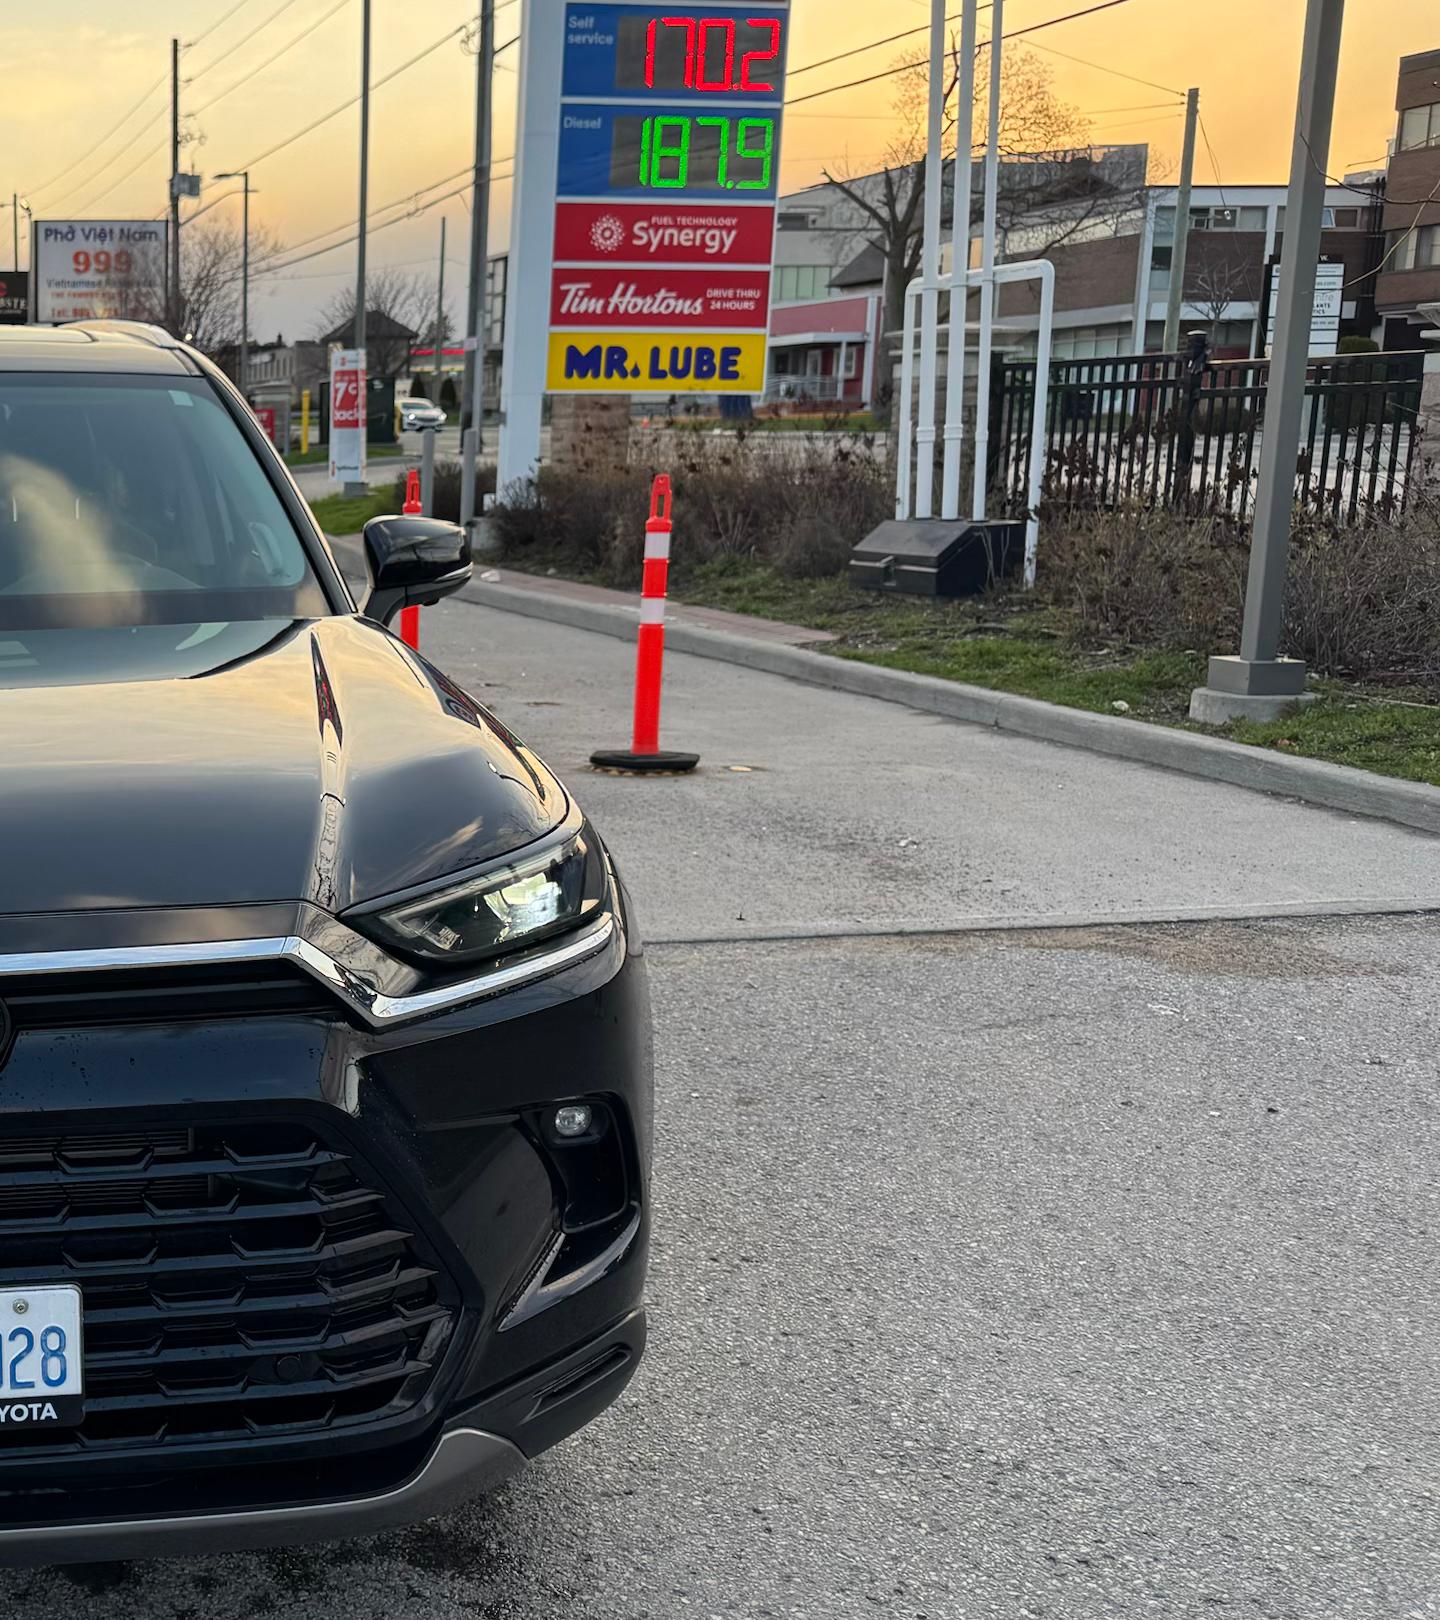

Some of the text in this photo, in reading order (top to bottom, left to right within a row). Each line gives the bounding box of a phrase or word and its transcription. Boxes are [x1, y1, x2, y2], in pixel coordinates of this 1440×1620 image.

[568, 16, 595, 29] Self
[567, 32, 614, 45] service
[644, 17, 781, 92] 170.2
[563, 116, 602, 129] Diesel
[639, 115, 774, 190] 187.9
[651, 216, 738, 226] FUEL TECHNOLOGY
[119, 227, 158, 242] Nam
[632, 220, 738, 254] Synergy
[72, 250, 132, 274] 999
[560, 281, 703, 315] Tim Hortons
[707, 288, 760, 299] DRIVE THRU
[710, 301, 755, 310] 24 HOURS
[649, 346, 742, 380] LUBE
